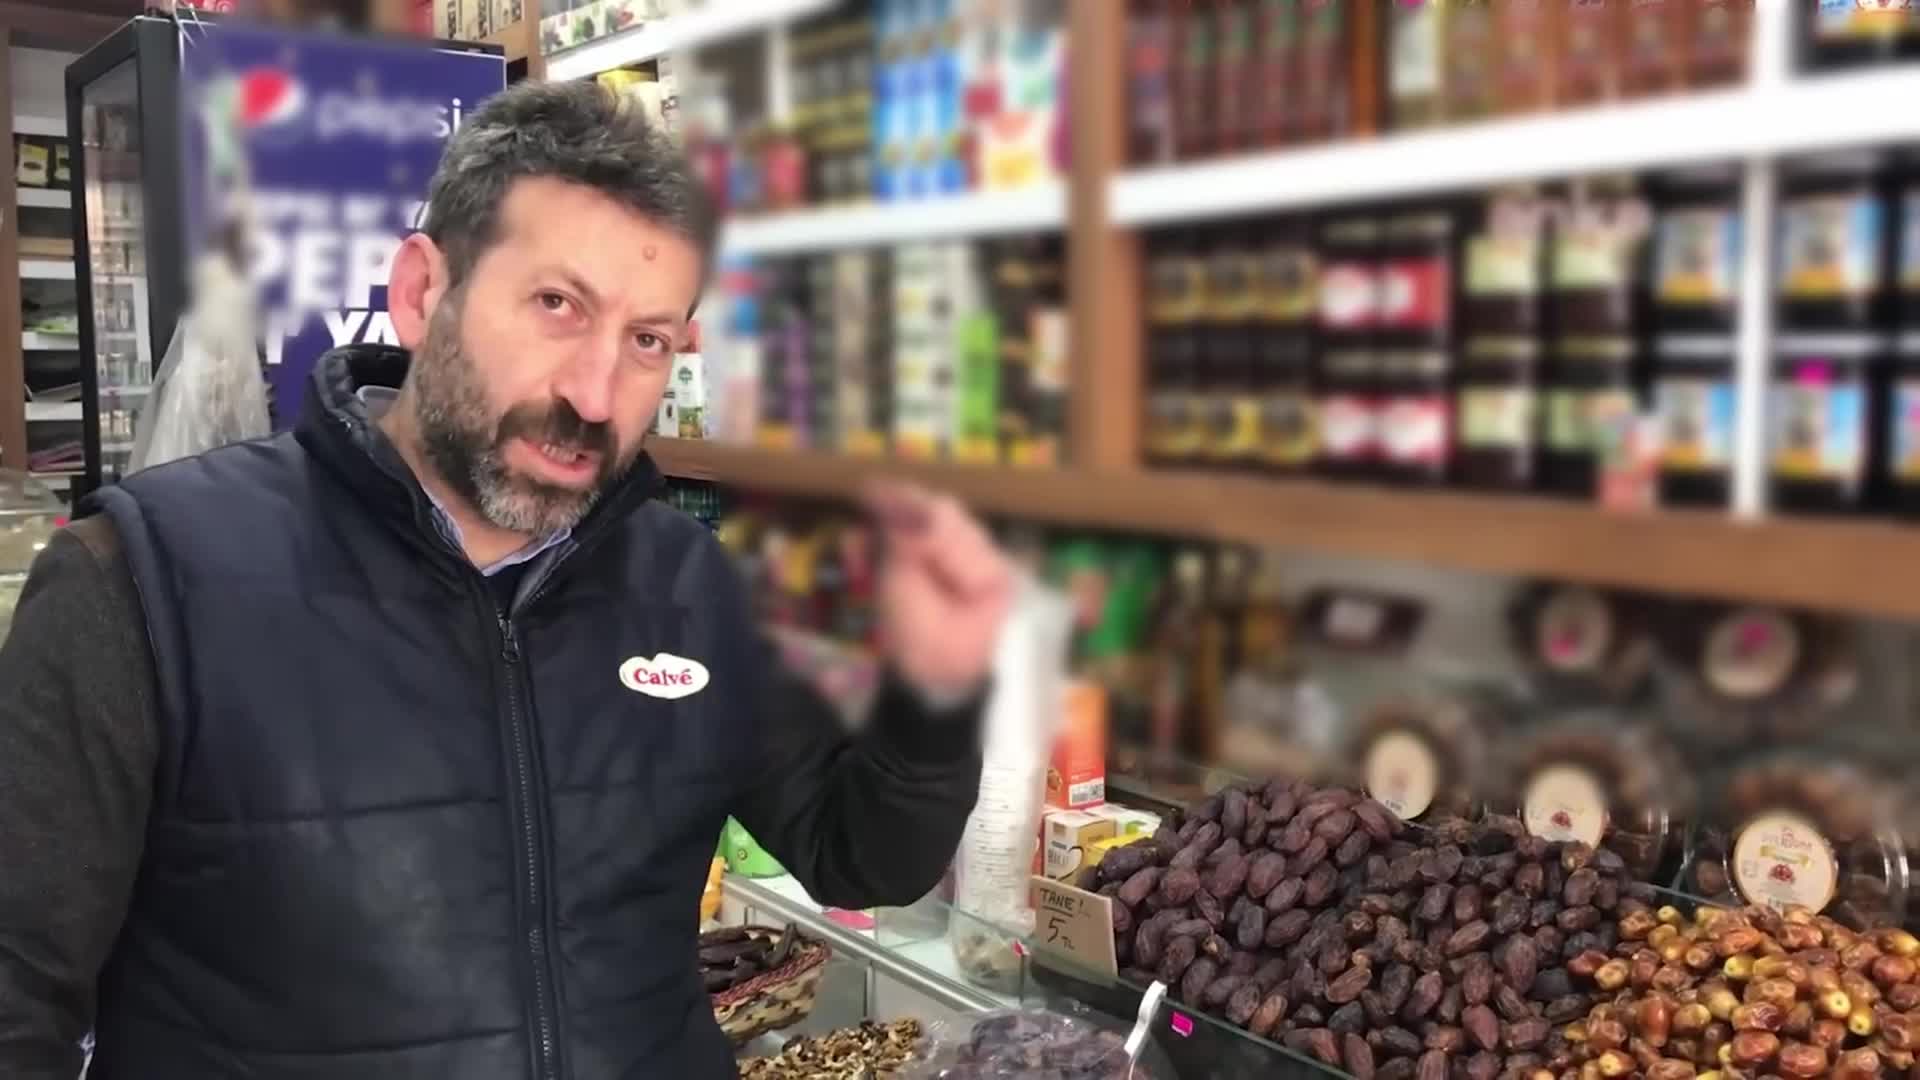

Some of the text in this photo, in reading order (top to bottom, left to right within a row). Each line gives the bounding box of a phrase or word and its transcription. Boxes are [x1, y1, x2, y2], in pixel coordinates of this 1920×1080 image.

[633, 667, 694, 686] Calvé
[1040, 887, 1075, 911] TANE
[1047, 916, 1066, 943] 5
